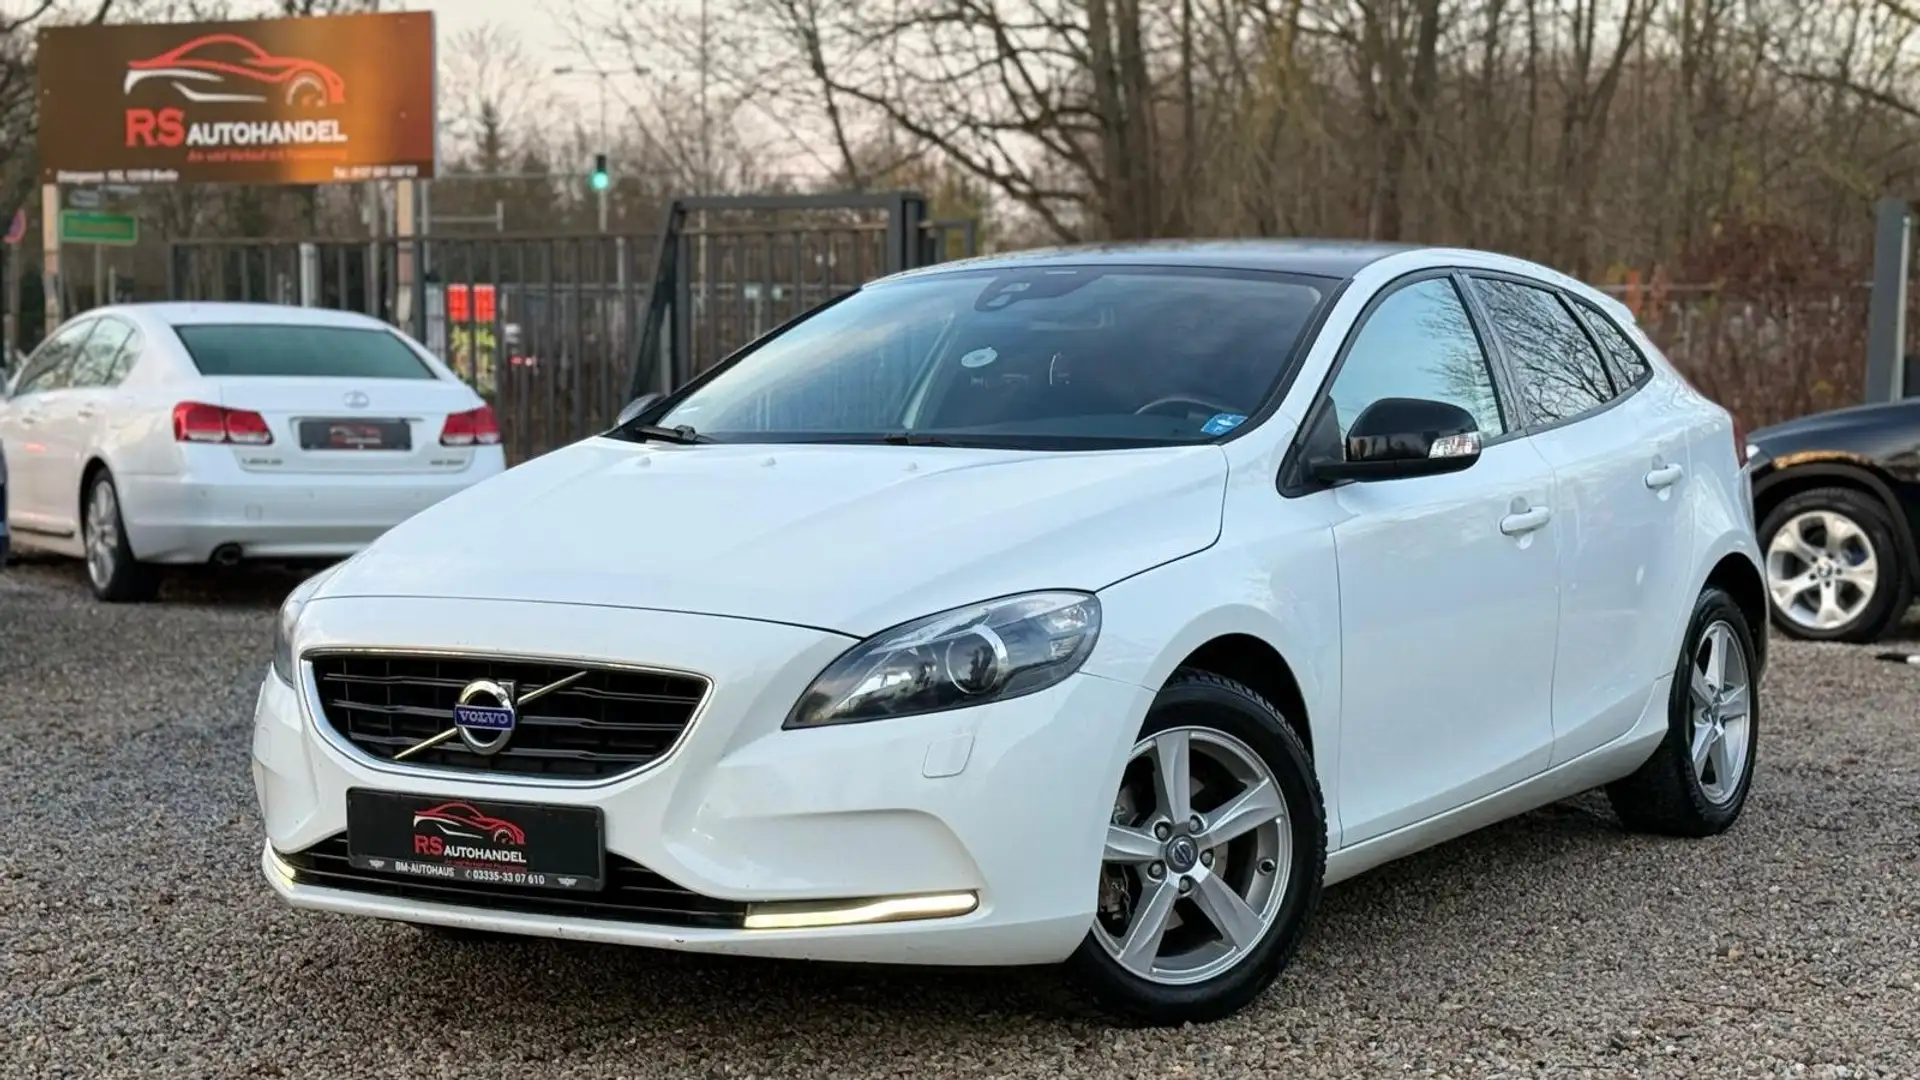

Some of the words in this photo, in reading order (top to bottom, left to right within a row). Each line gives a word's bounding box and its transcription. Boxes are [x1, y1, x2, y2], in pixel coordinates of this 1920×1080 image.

[125, 108, 185, 148] RS
[186, 120, 348, 146] AUTOHANDEL
[458, 710, 509, 725] VOLVO
[414, 834, 443, 855] RS
[444, 845, 527, 863] AUTOHANDEL
[395, 861, 454, 877] BM-AUTOHAUS
[472, 869, 513, 882] 03335-33
[514, 873, 526, 883] 07
[527, 874, 545, 885] 610
